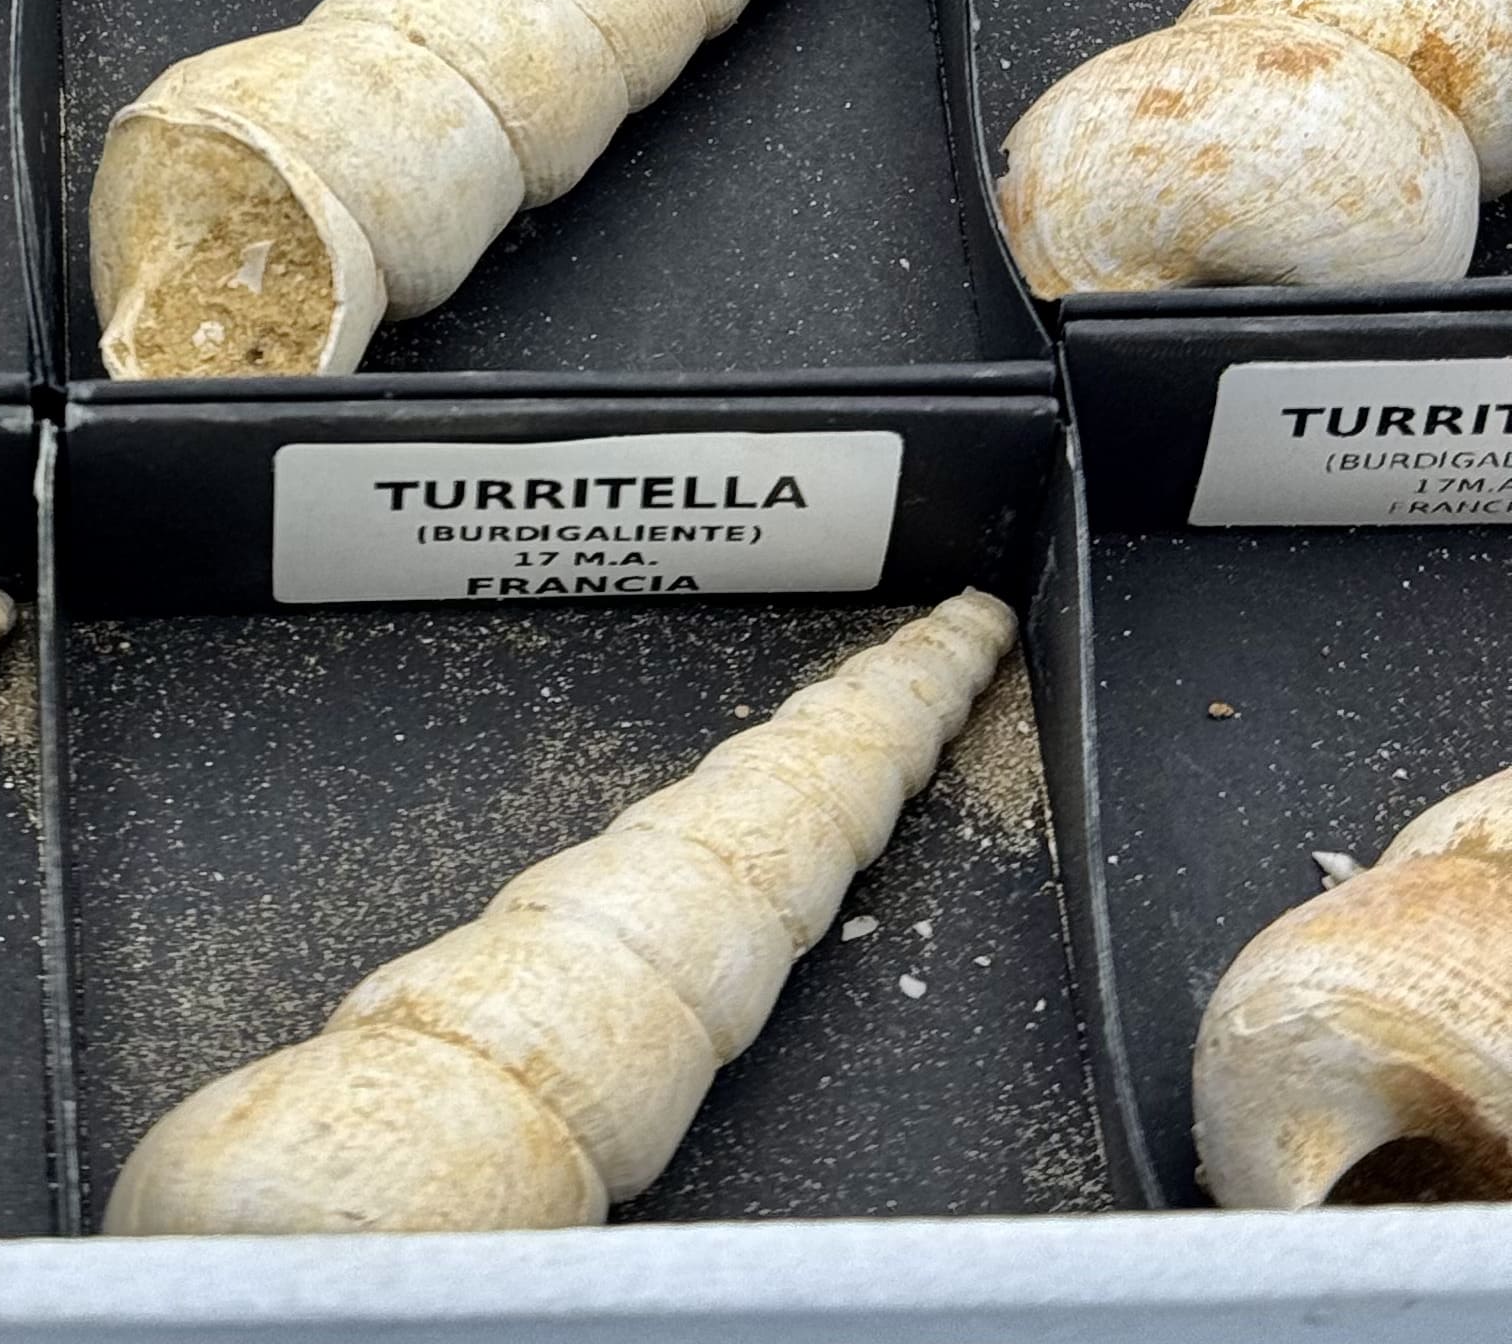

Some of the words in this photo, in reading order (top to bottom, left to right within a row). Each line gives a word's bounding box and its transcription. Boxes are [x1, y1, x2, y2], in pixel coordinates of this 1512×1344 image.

[375, 475, 807, 511] TURRITELLA
[417, 524, 762, 545] (BURDIGALIENTE)
[514, 551, 559, 568] 17
[574, 550, 658, 567] M.A.
[467, 574, 701, 596] FRANCIA
